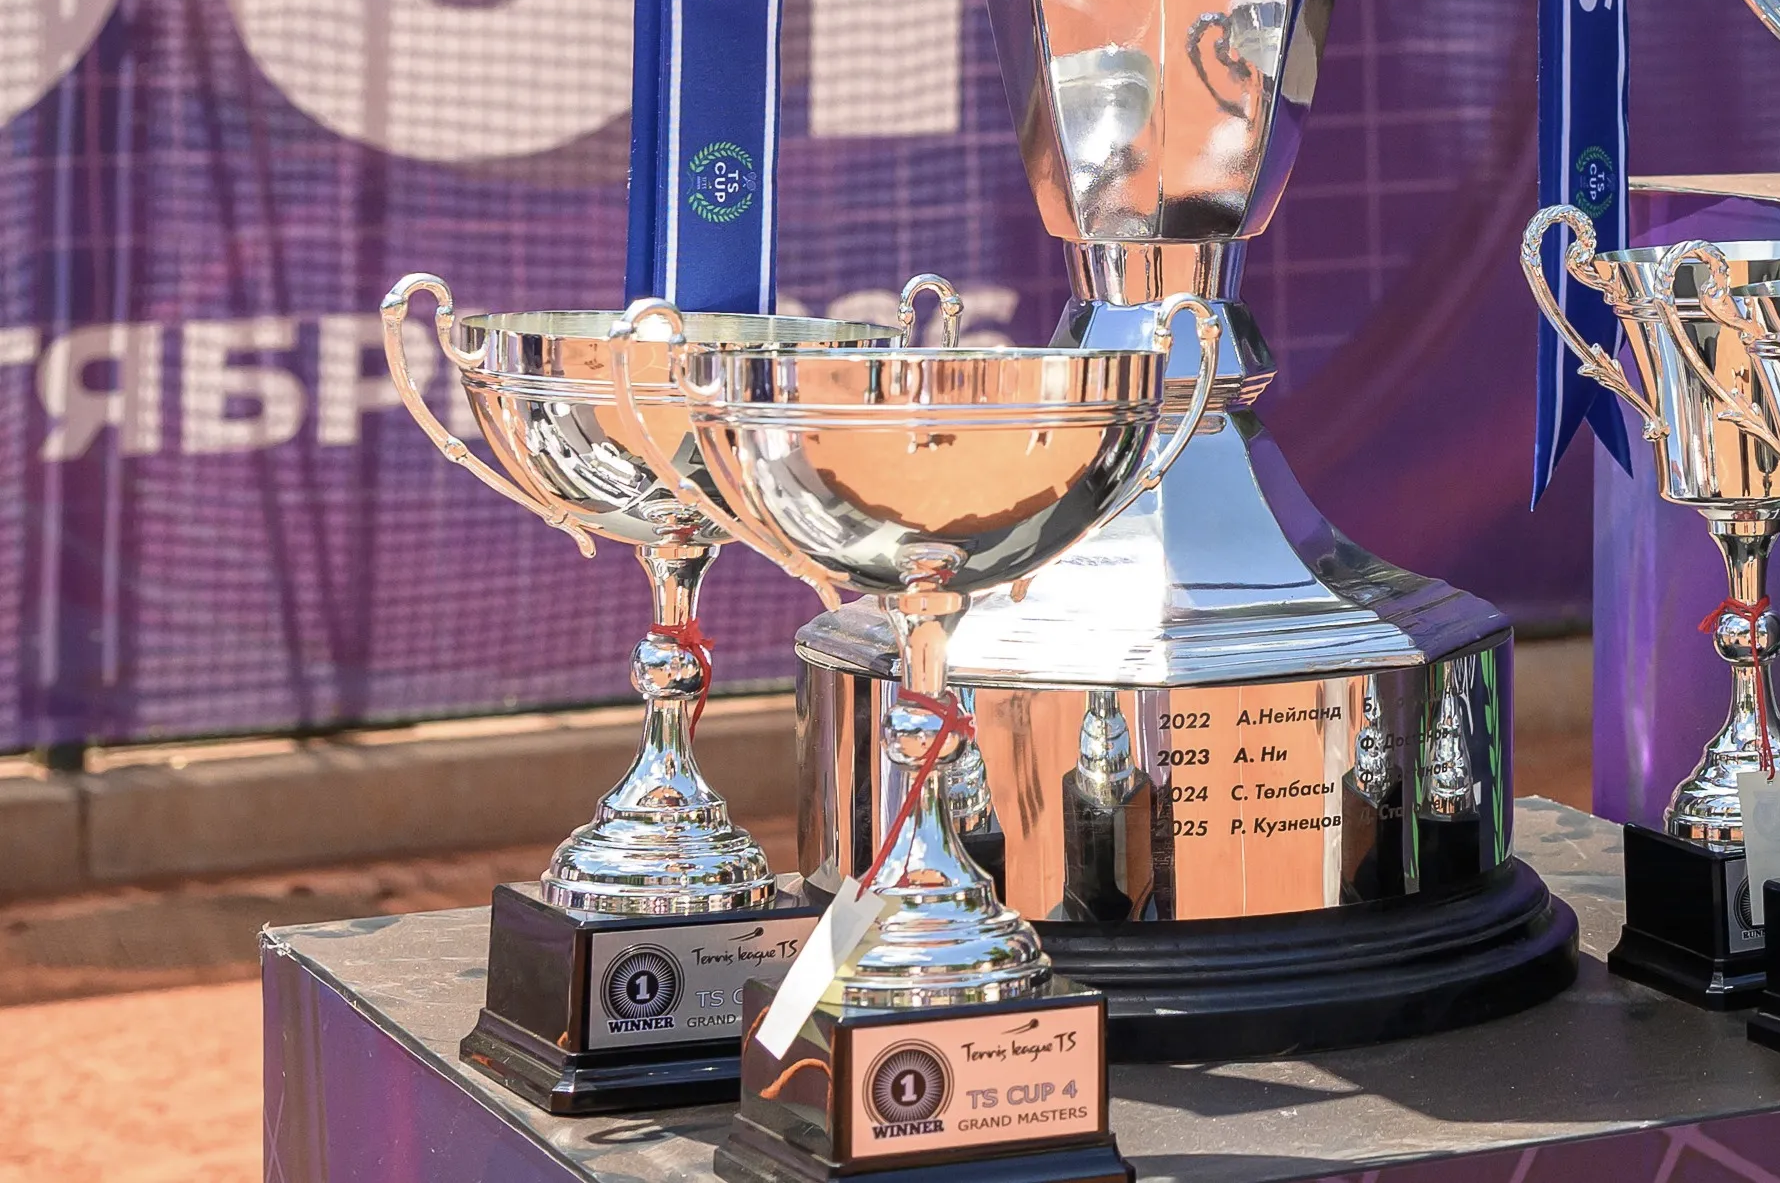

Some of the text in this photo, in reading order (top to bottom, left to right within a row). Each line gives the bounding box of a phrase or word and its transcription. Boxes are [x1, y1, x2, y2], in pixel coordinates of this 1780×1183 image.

[714, 161, 726, 203] CUP
[727, 170, 739, 193] TS
[1589, 163, 1597, 200] CUP
[1597, 171, 1605, 192] TS
[1158, 713, 1211, 730] 2022
[1157, 746, 1288, 766] 2023 А. Ни
[1231, 785, 1249, 801] С.
[1255, 780, 1335, 800] Төлбасы
[1231, 819, 1246, 835] Р.
[1254, 815, 1342, 837] Кузнецов
[691, 939, 799, 968] Tennis league TS
[635, 975, 650, 1000] 1
[695, 990, 724, 1008] TS
[608, 1017, 675, 1034] WINNER
[687, 1014, 736, 1028] GRAND
[961, 1030, 1077, 1063] Tennis league TS
[900, 1074, 917, 1102] 1
[966, 1079, 1079, 1109] TS CUP 4
[872, 1120, 944, 1140] WINNER
[958, 1106, 1088, 1132] GRAND MASTERS
